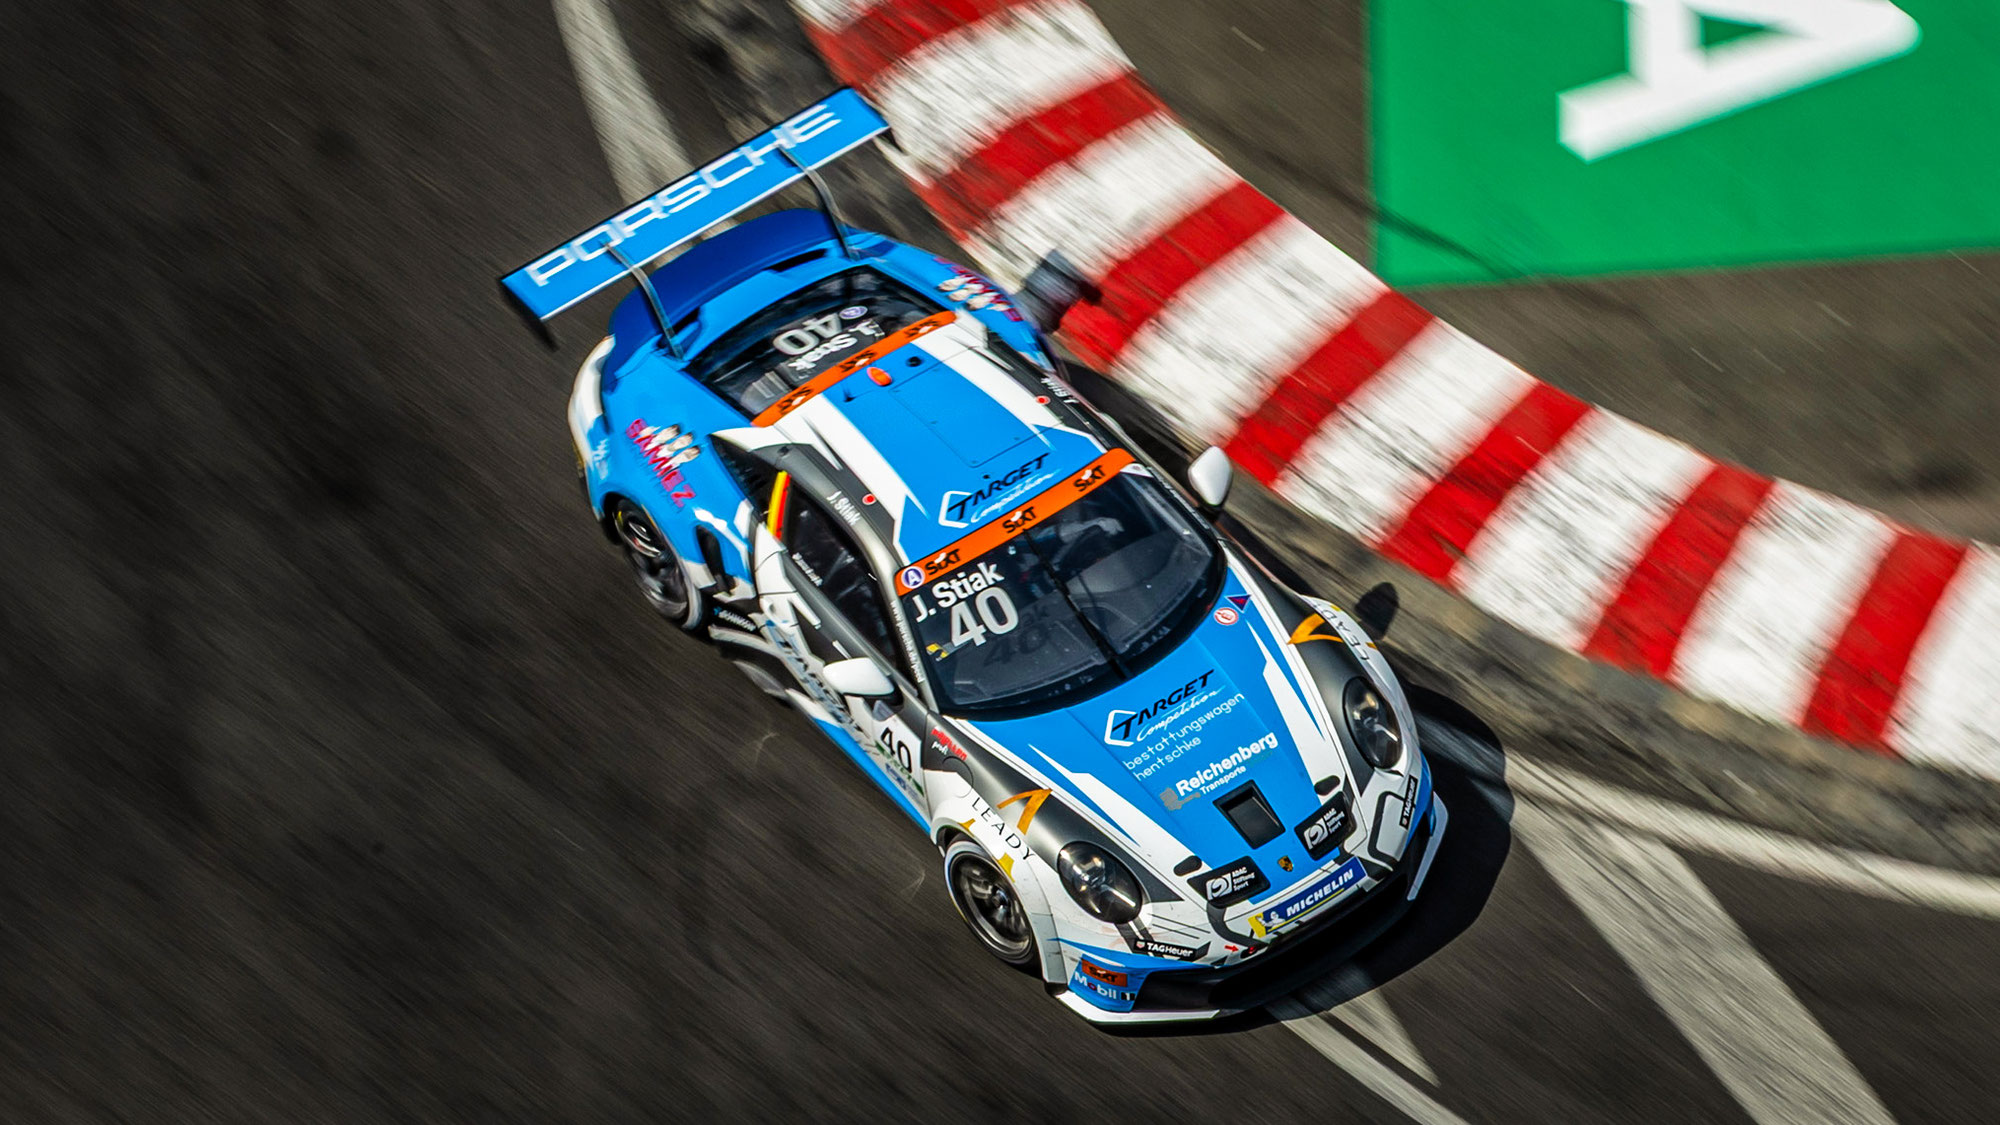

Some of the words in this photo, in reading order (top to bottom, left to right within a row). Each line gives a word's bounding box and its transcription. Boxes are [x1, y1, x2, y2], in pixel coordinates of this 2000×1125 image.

[526, 104, 842, 287] PORSCHE
[772, 313, 843, 356] 40
[946, 453, 1050, 522] TARGET
[912, 594, 937, 623] J.
[931, 561, 1005, 609] Stiak
[950, 586, 1019, 647] 40
[1111, 669, 1215, 740] TARGET
[1122, 692, 1245, 771] bestattungswagen
[1136, 685, 1226, 742] Competition
[880, 726, 913, 774] 40
[1133, 736, 1202, 782] hentschke
[1175, 732, 1279, 797] Reichenberg
[1199, 765, 1247, 795] Transporte
[972, 797, 1037, 861] LEADY
[1286, 868, 1354, 917] MICHELIN
[1074, 971, 1118, 1000] Mobil
